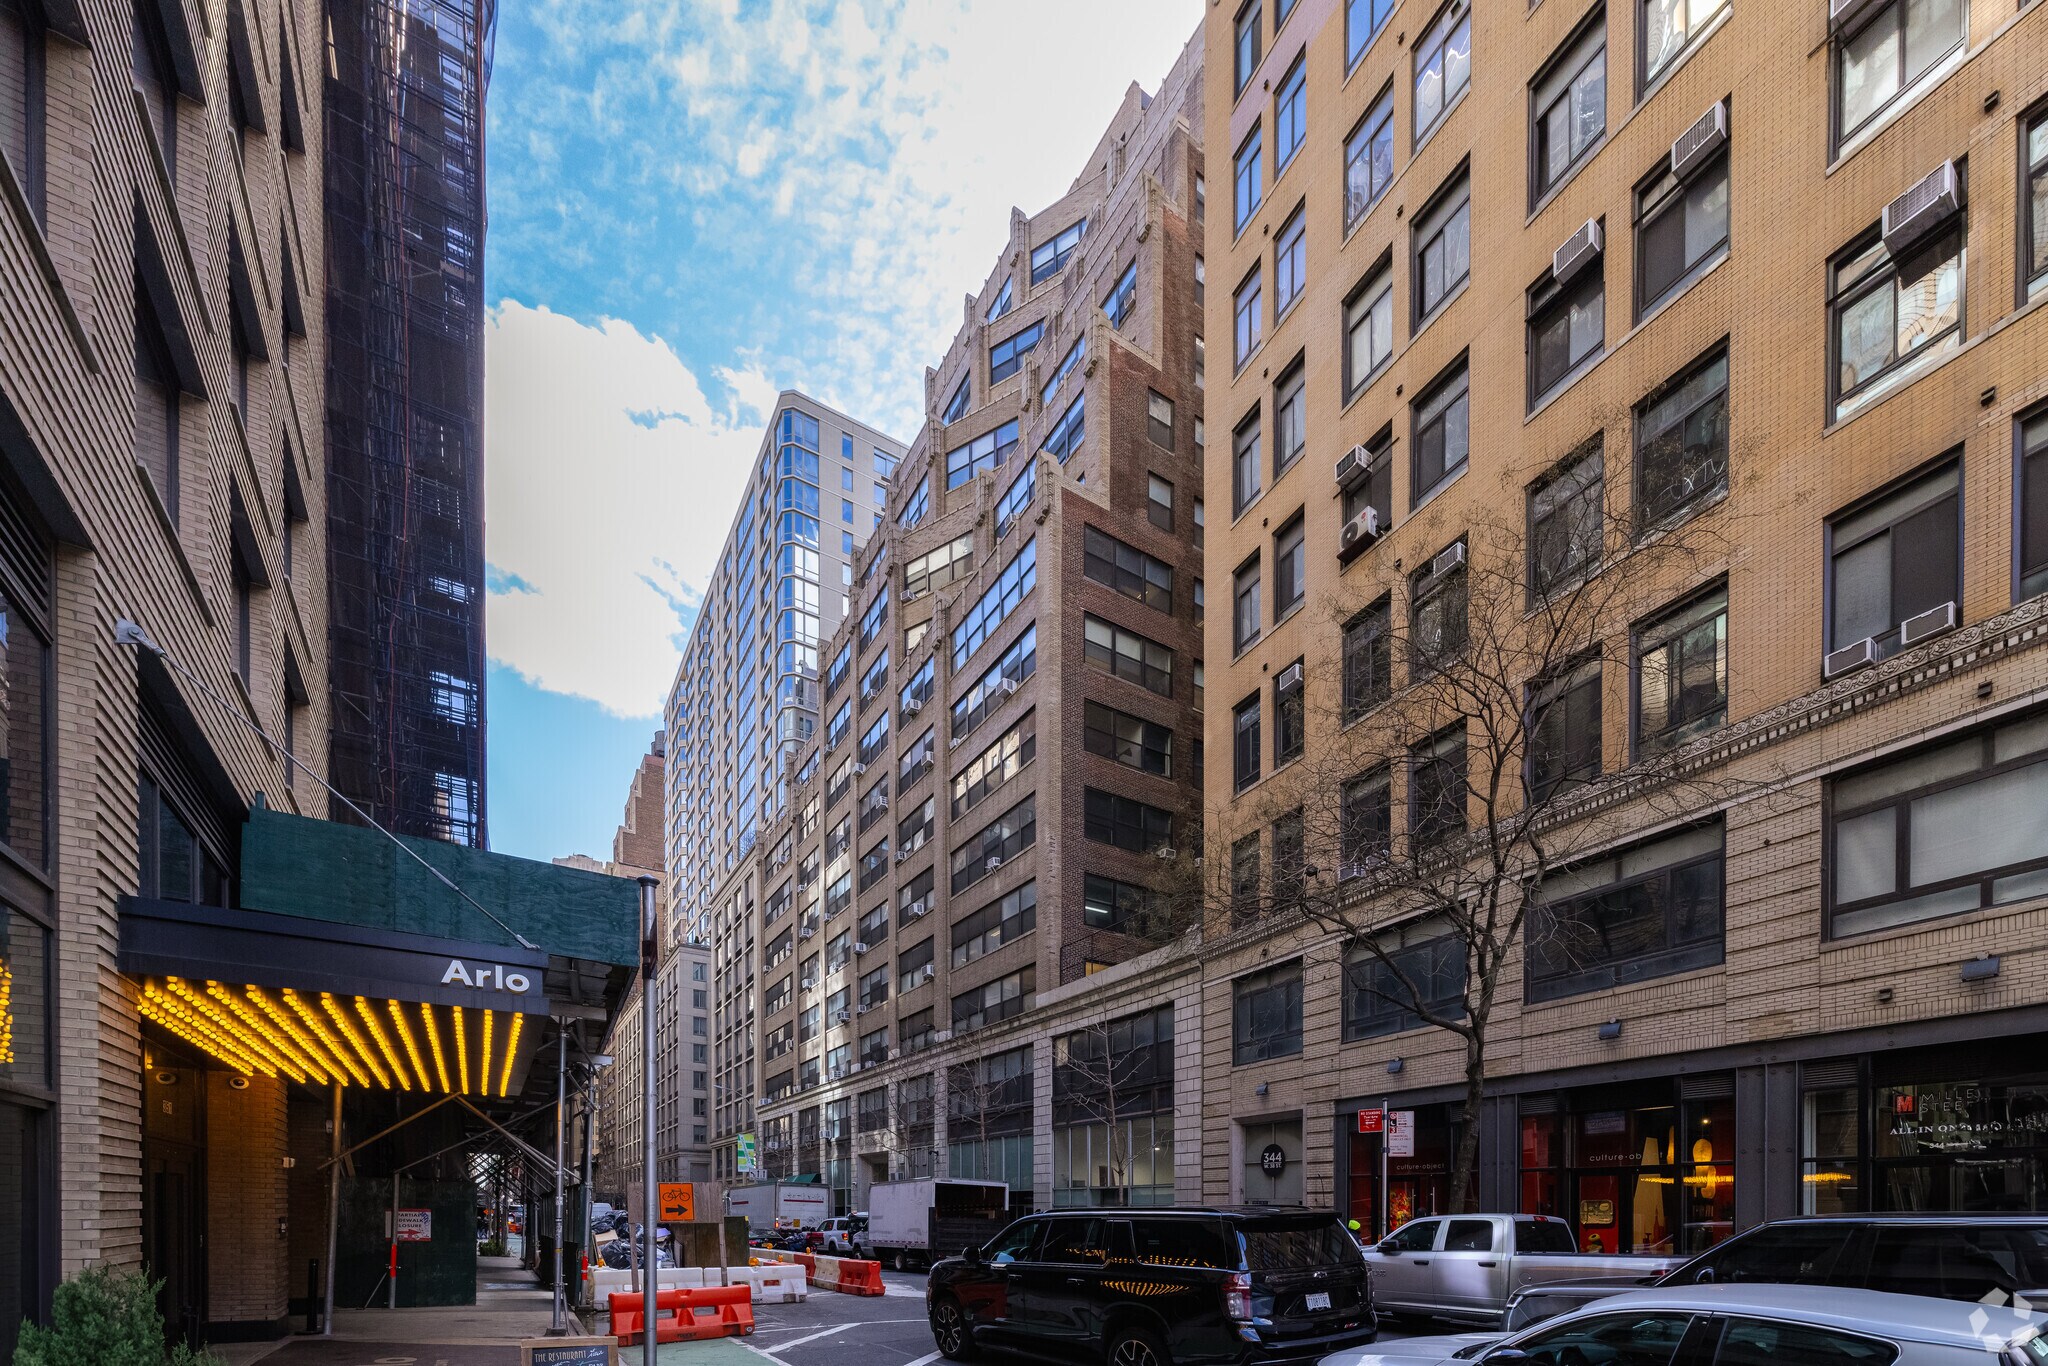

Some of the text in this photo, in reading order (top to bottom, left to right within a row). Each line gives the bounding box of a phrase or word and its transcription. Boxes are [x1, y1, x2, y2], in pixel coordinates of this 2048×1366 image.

[441, 960, 530, 992] Arlo
[1263, 1152, 1282, 1163] 344
[535, 1353, 547, 1362] THE
[549, 1350, 586, 1361] RESTAURANT
